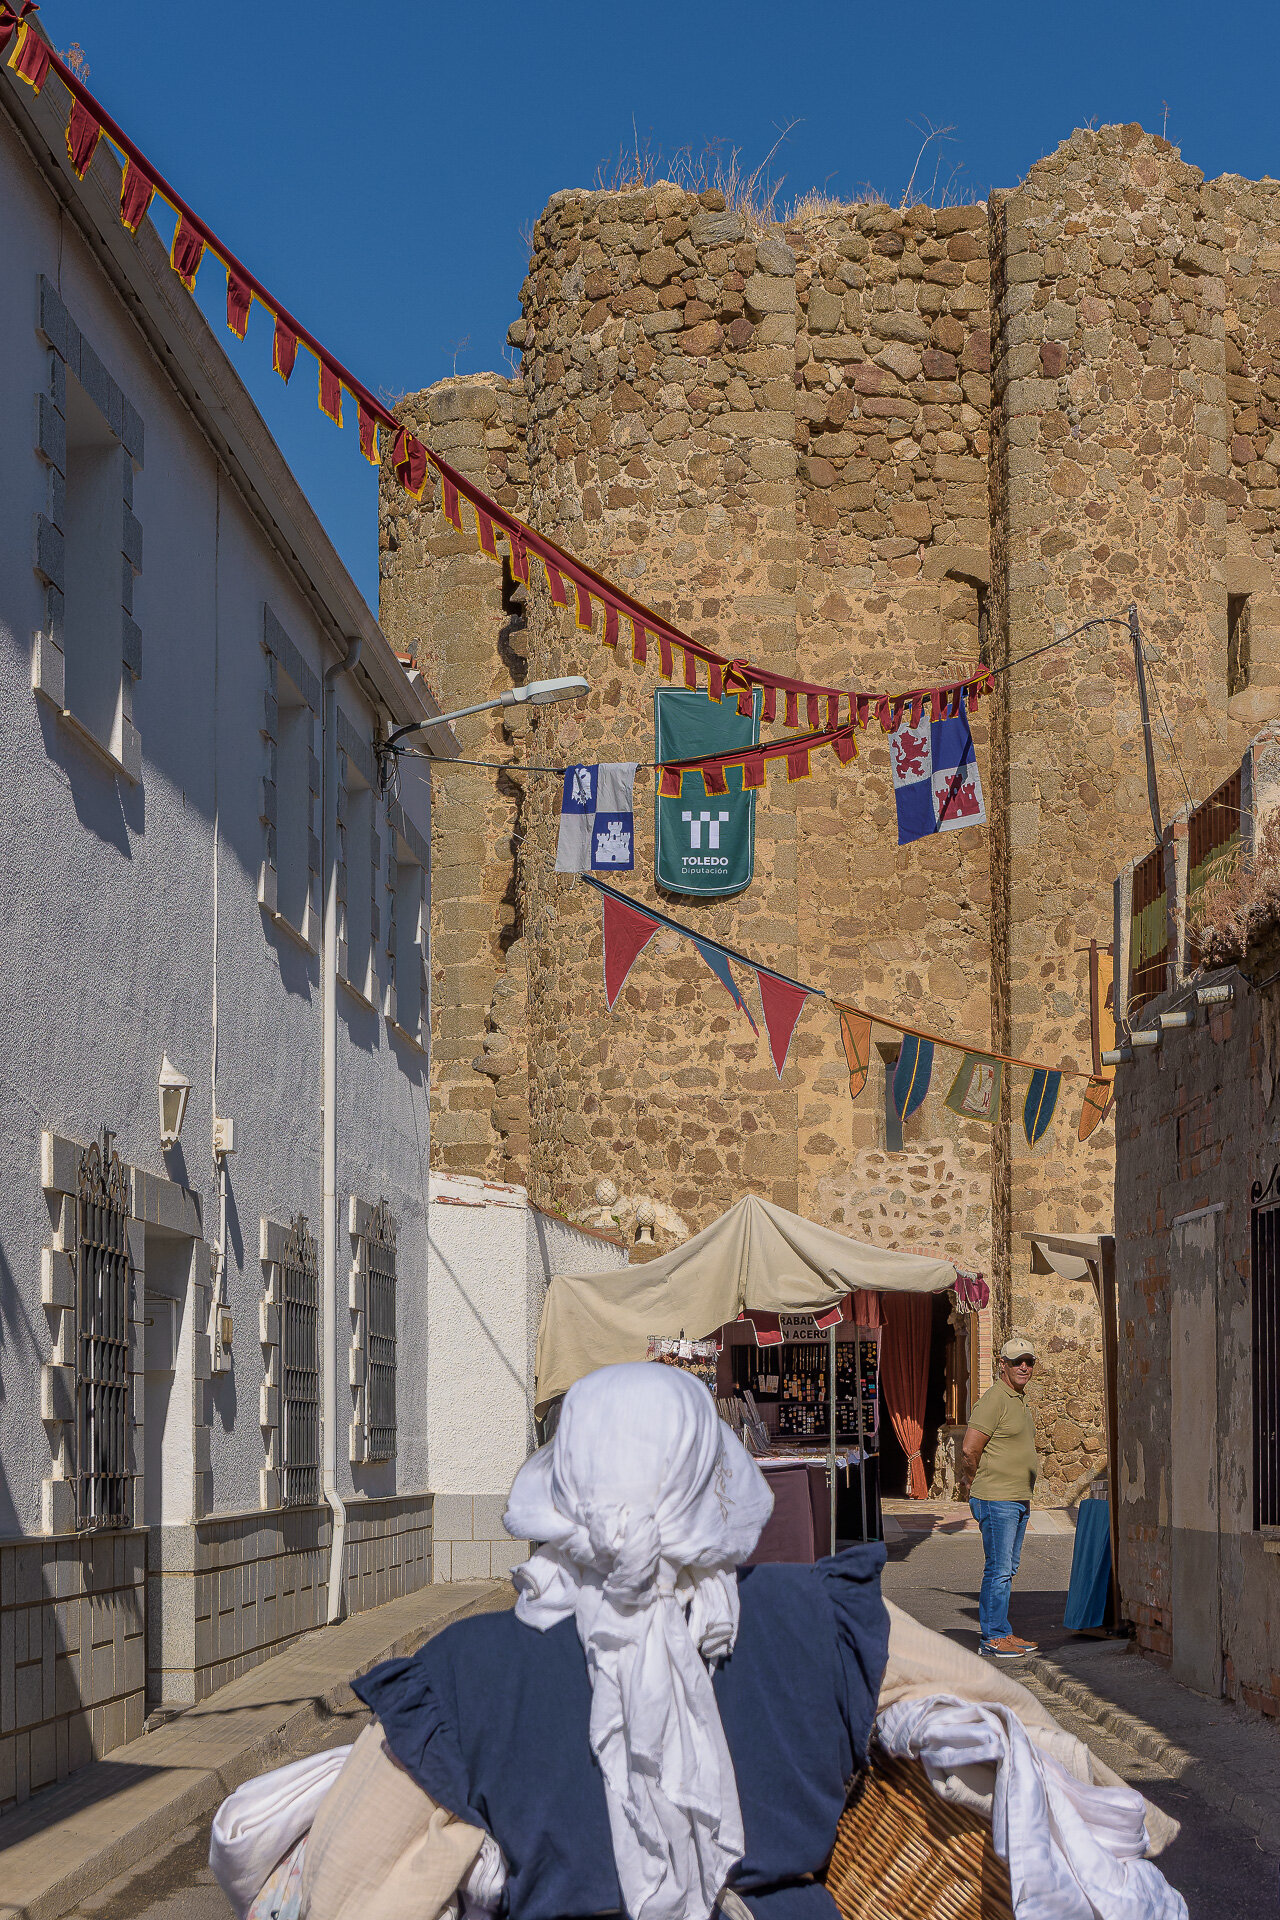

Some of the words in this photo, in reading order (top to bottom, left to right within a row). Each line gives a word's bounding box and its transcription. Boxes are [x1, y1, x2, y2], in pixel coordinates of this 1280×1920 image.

[681, 857, 729, 866] TOLEDO
[681, 867, 728, 875] Diputación
[780, 1316, 814, 1325] RABAD
[793, 1330, 828, 1339] ACERO
